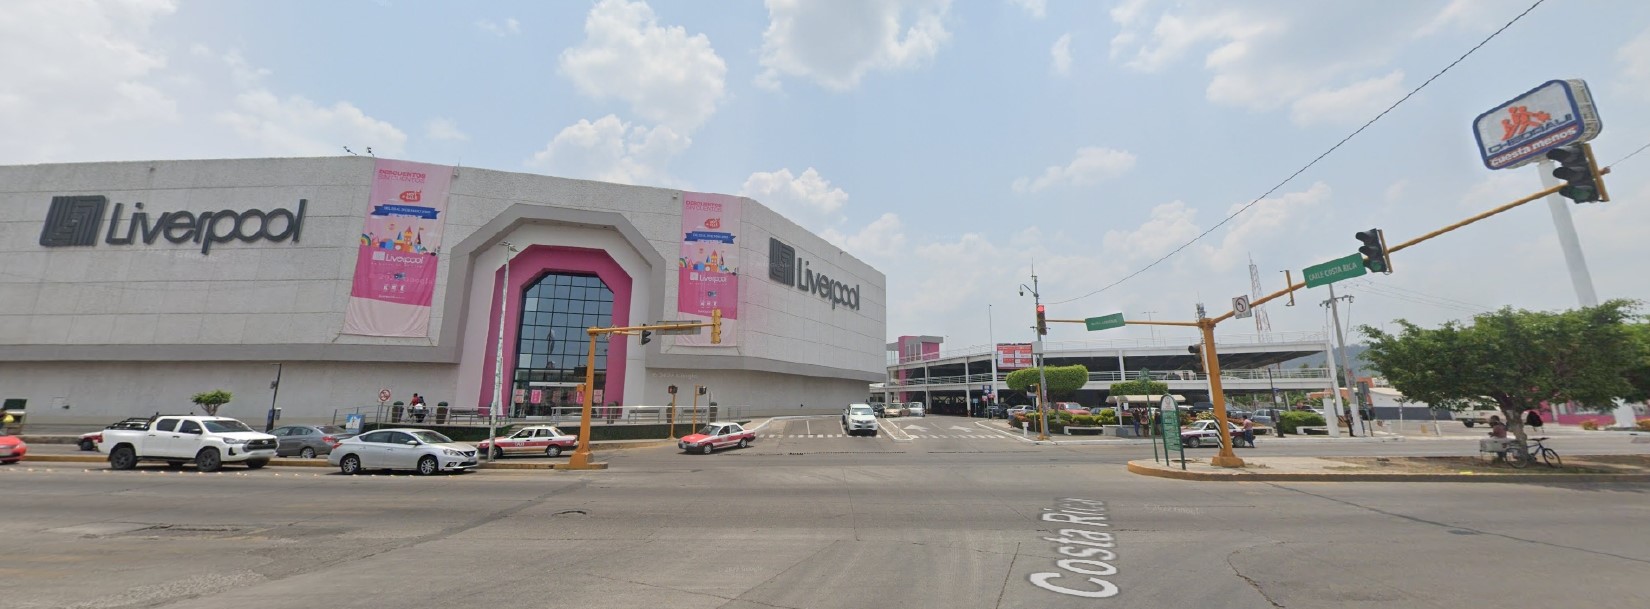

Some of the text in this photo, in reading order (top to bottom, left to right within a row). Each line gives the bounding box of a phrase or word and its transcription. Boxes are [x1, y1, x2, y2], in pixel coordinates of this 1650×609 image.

[1490, 127, 1577, 167] cuesta menos
[106, 198, 308, 255] Liverpool
[385, 253, 424, 265] Liverpool
[1308, 262, 1357, 281] CALLE COSTA RICA
[796, 256, 860, 312] Liverpool
